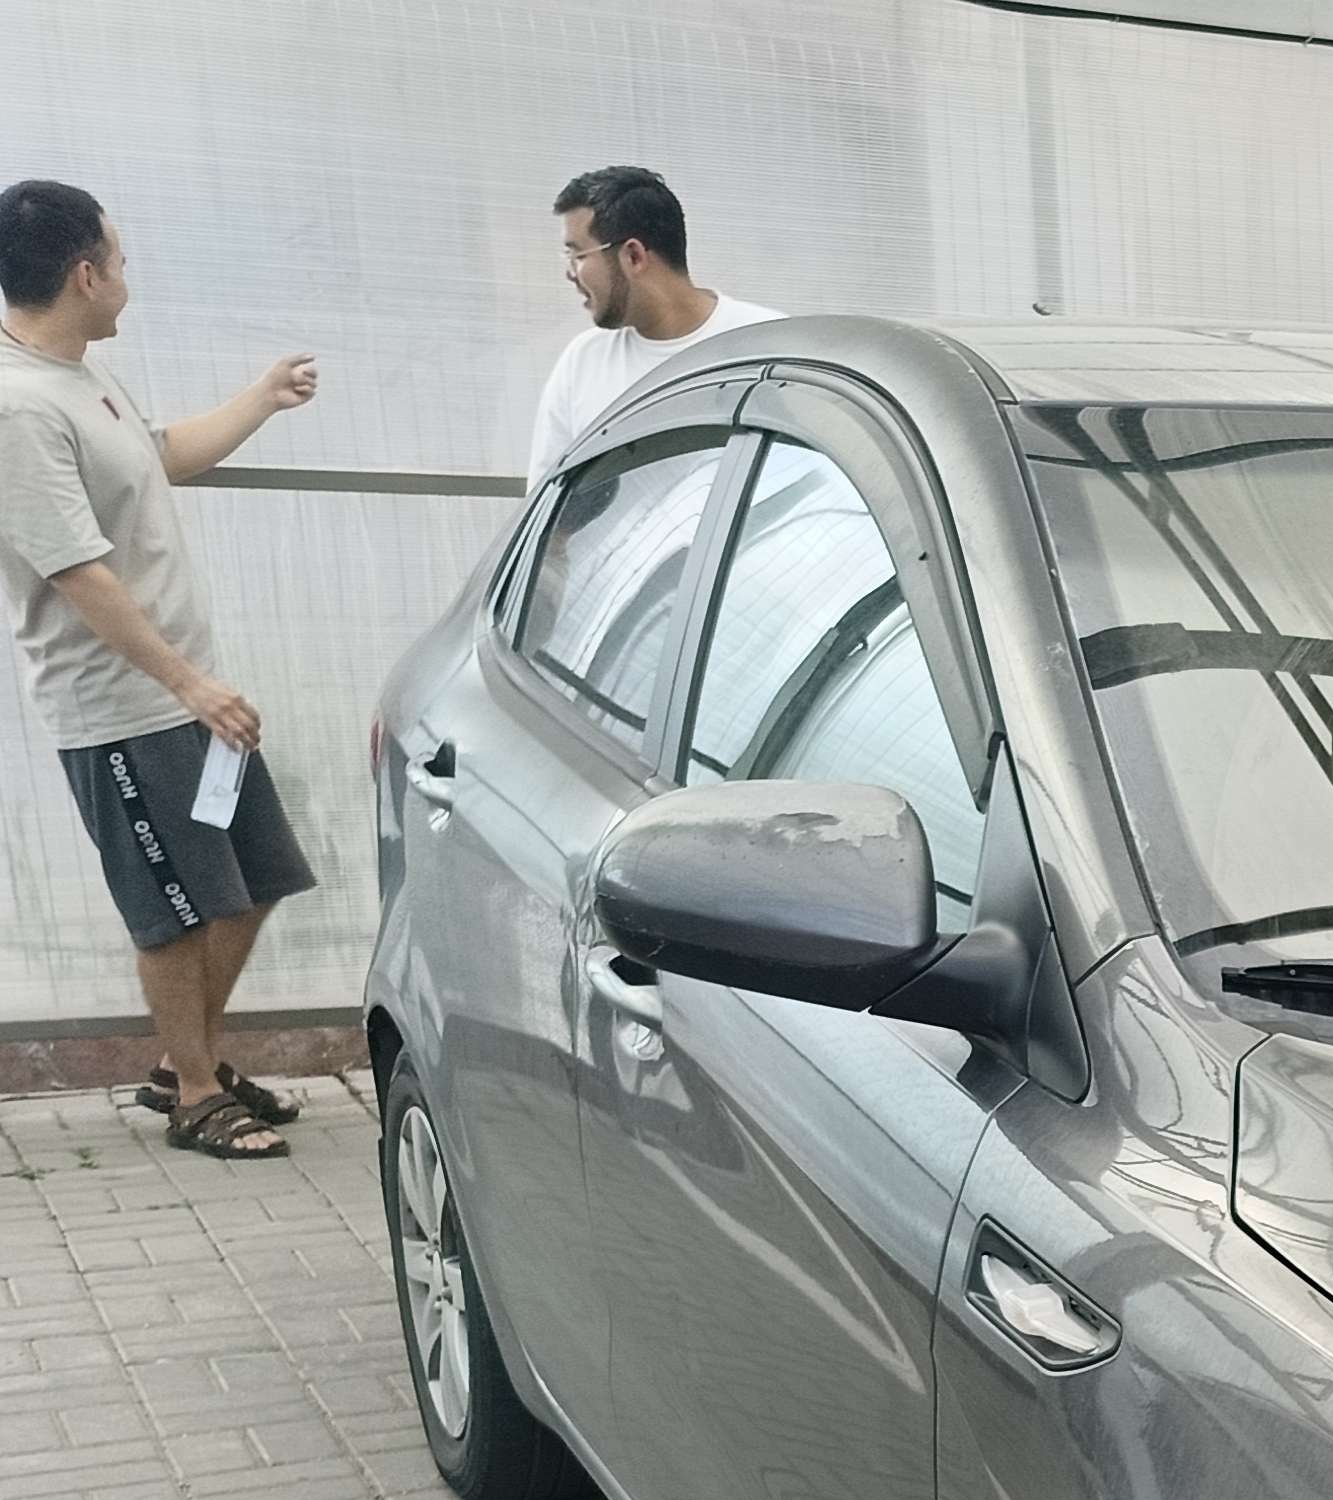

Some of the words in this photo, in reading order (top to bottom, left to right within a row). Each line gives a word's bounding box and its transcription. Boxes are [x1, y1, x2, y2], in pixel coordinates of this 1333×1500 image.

[109, 751, 138, 799] HUGO
[134, 819, 165, 864] HUGO
[164, 882, 200, 927] HUGO
